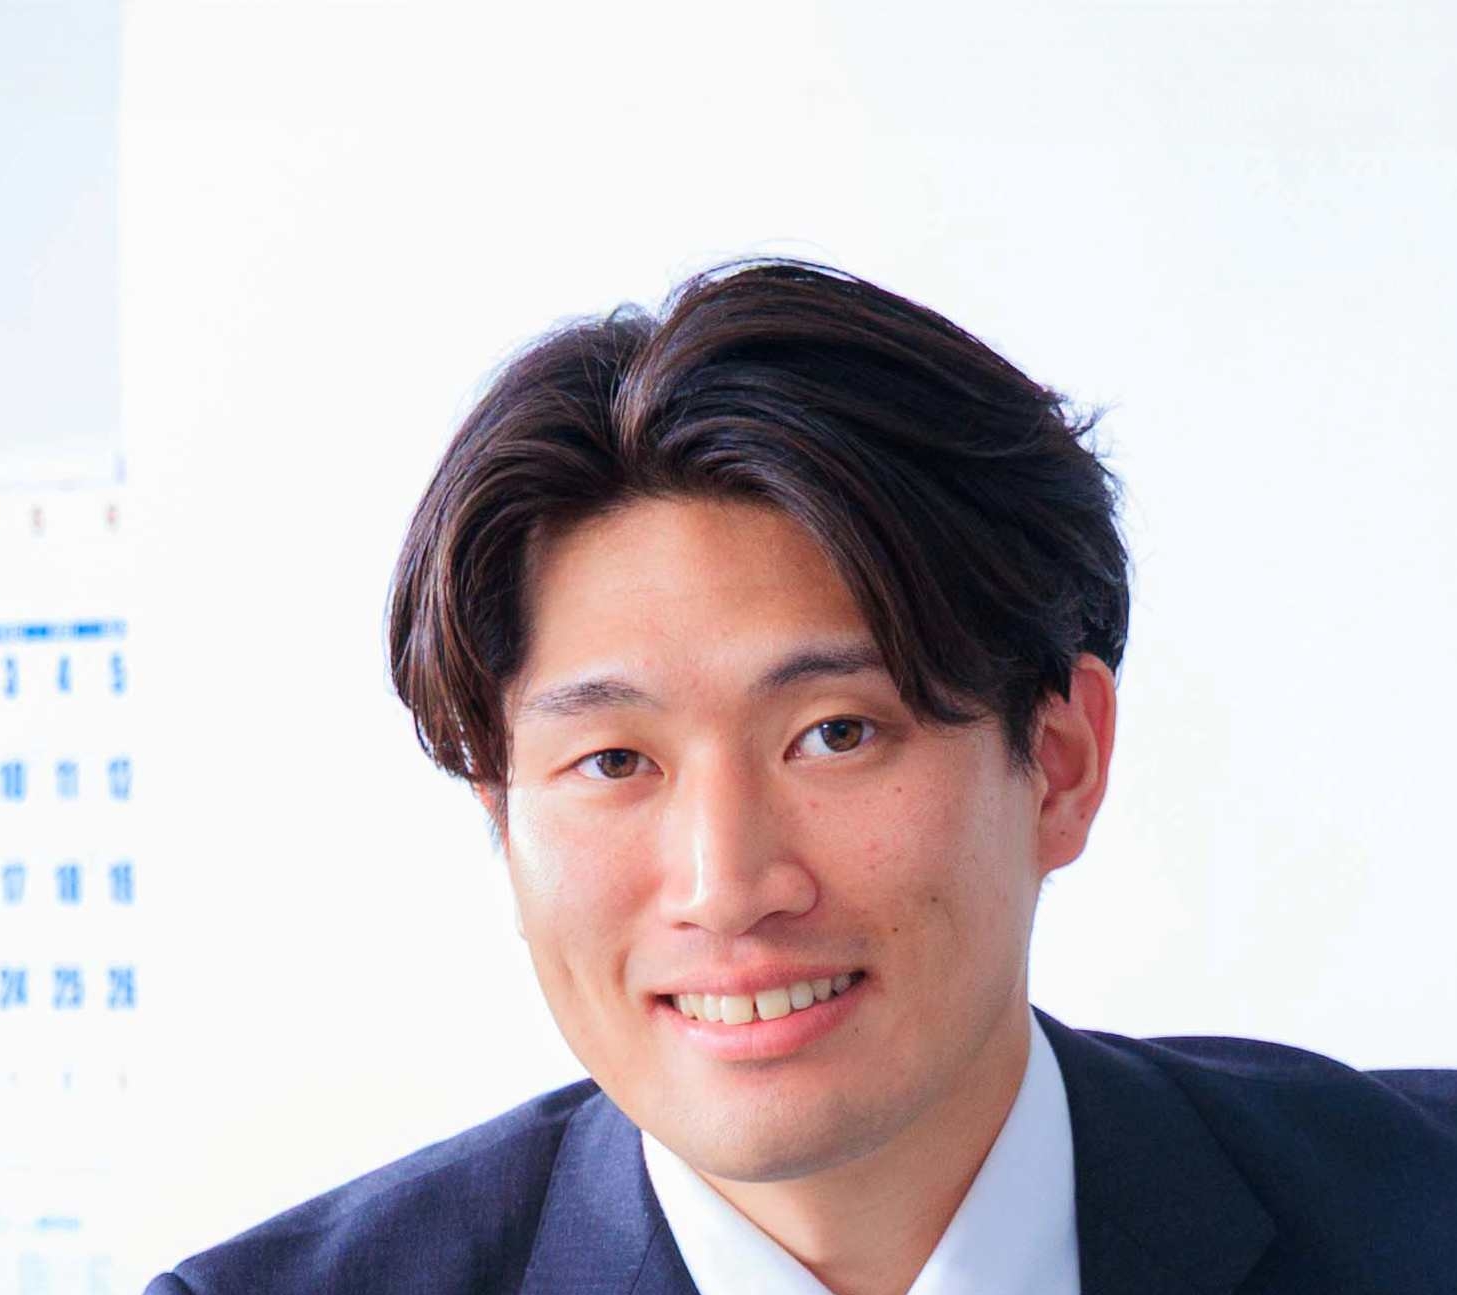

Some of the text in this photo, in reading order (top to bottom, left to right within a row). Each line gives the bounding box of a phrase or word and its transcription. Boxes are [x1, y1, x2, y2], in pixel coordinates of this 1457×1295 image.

[1, 654, 20, 700] 3
[54, 654, 72, 695] 4
[109, 650, 127, 696] 5
[54, 758, 80, 800] 11
[106, 754, 133, 803] 12
[0, 860, 28, 905] 17
[53, 860, 83, 906] 18
[107, 858, 136, 905] 19
[51, 964, 85, 1010] 25
[105, 963, 139, 1010] 26
